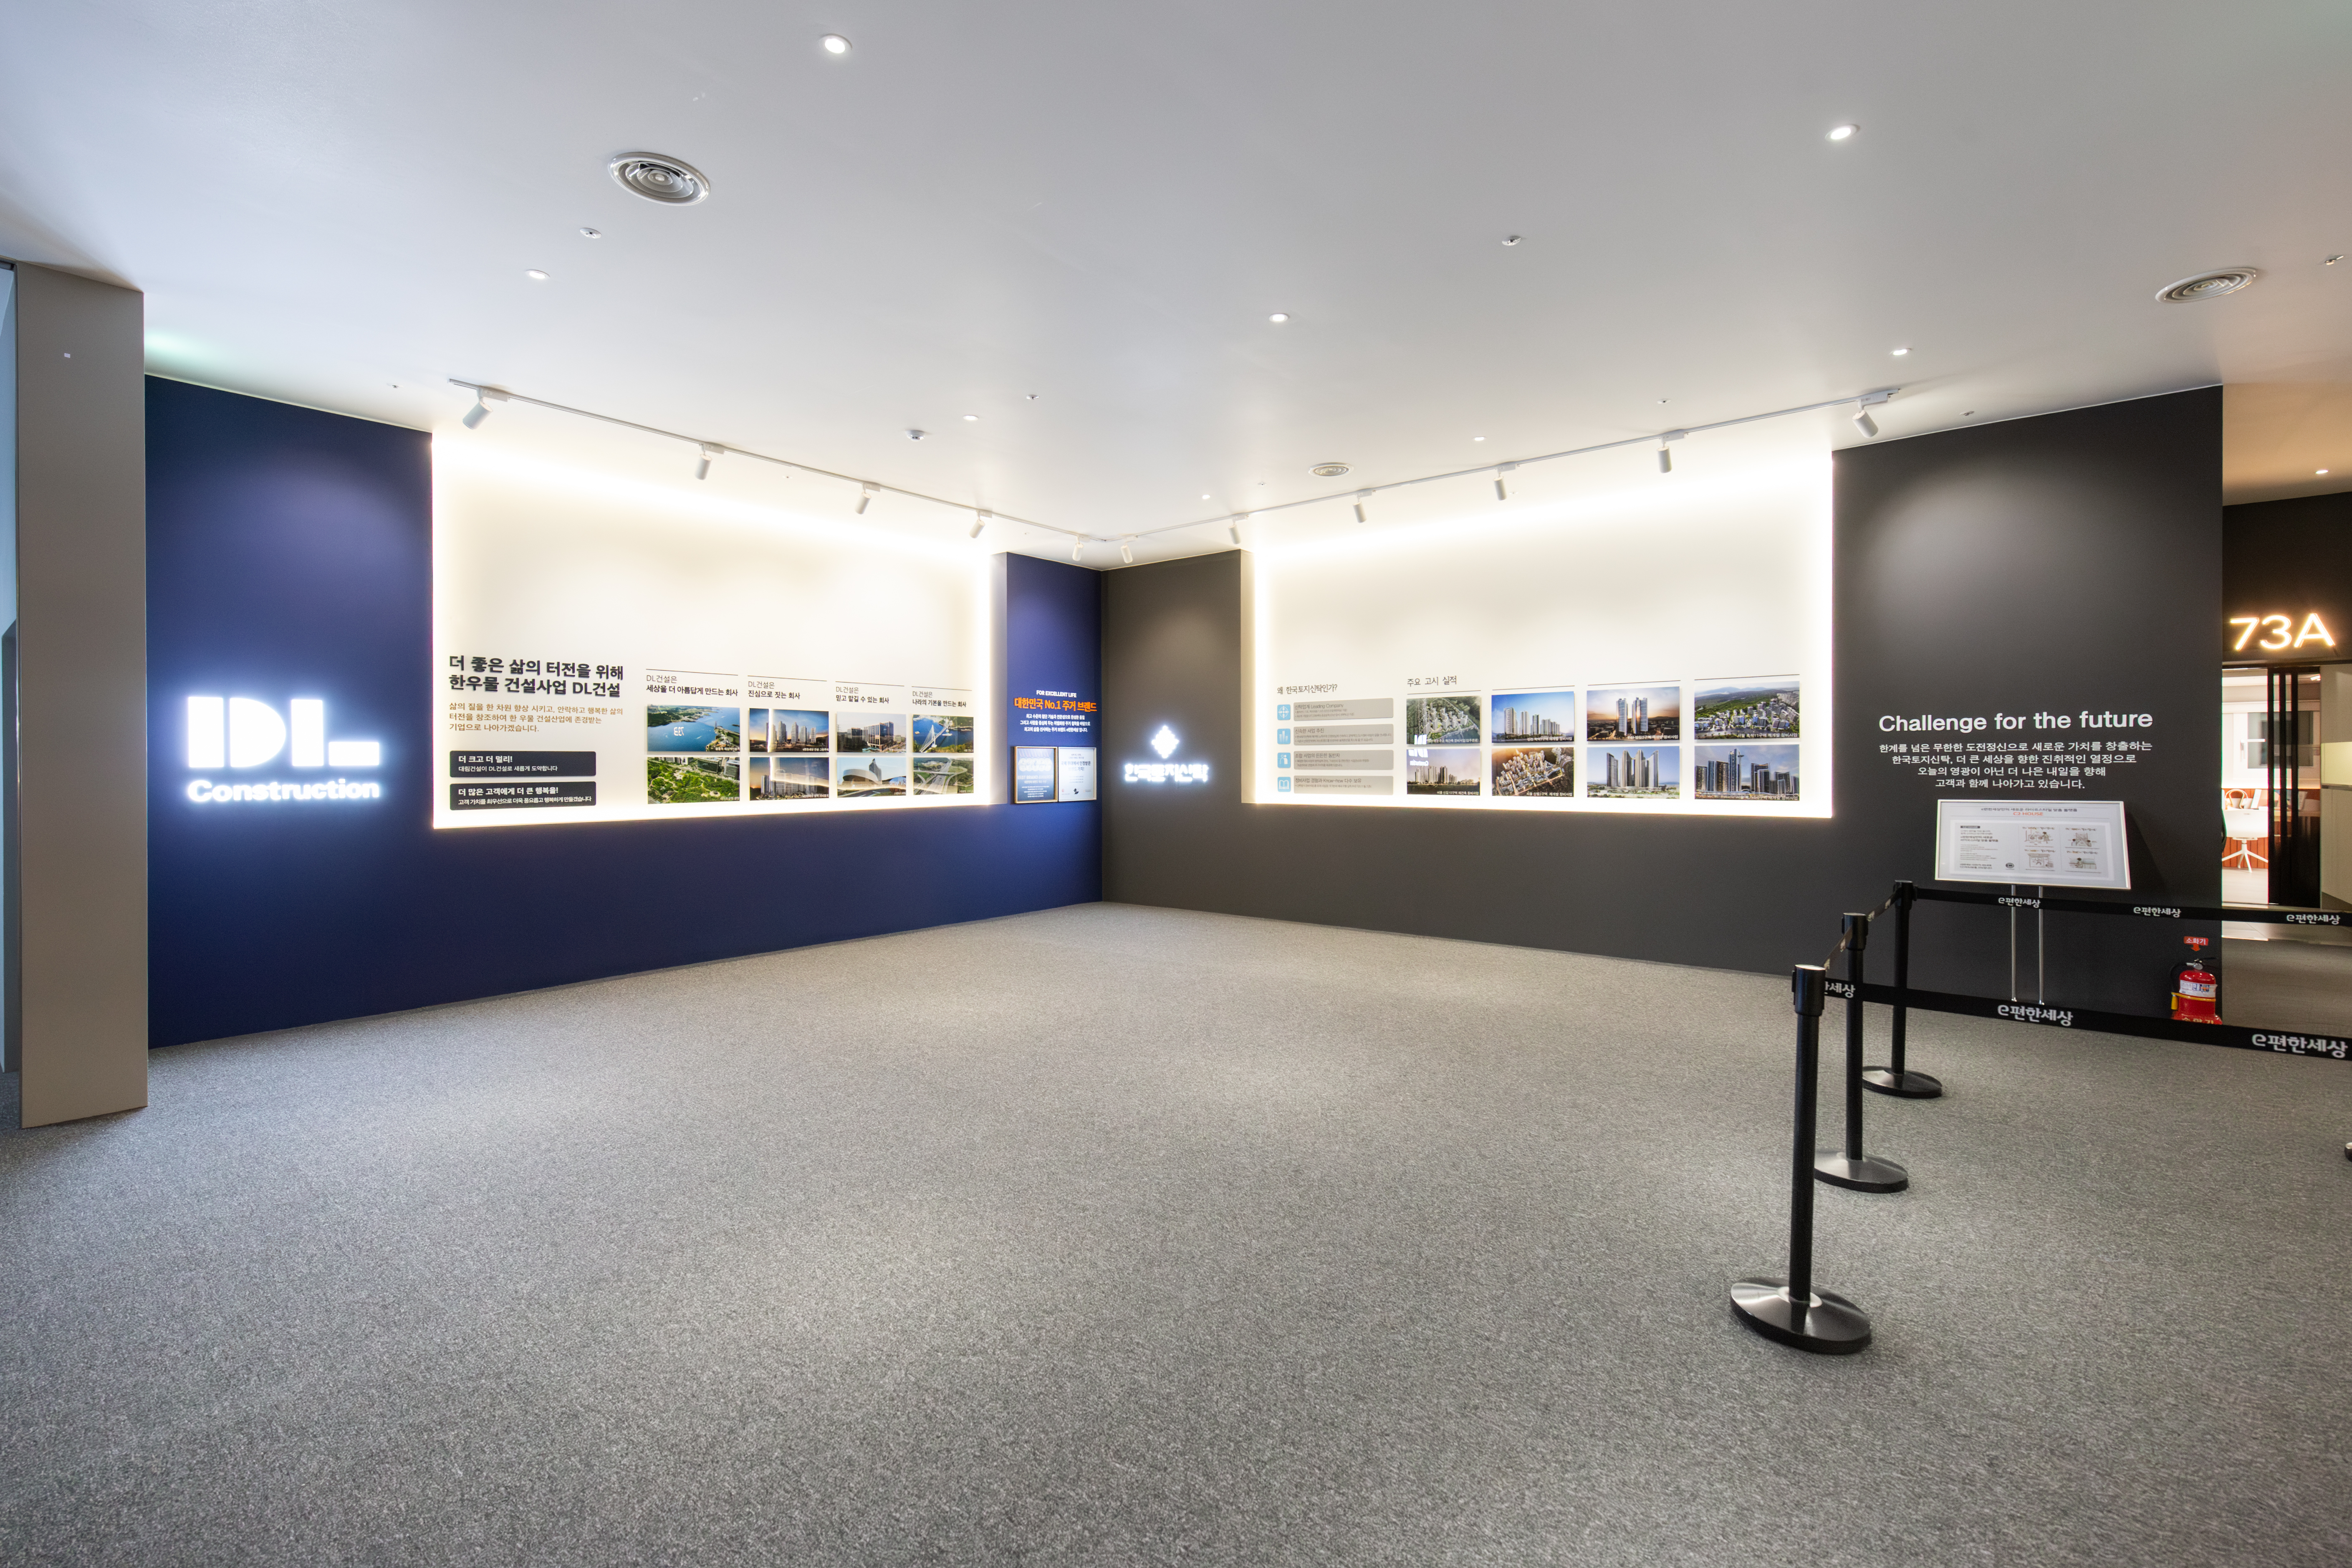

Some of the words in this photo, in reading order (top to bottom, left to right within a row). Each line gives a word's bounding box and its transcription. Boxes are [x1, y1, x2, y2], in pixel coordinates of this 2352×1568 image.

[2230, 613, 2335, 651] 73A
[450, 656, 464, 670] 더
[471, 656, 504, 673] 좋은
[509, 659, 540, 675] 삶의
[547, 662, 591, 678] 터전을
[596, 665, 623, 680] 위해
[647, 675, 677, 684] DL건설은
[748, 681, 775, 689] DL건설은
[1407, 678, 1421, 687] 주요
[1425, 677, 1438, 686] 고시
[1443, 676, 1457, 685] 실적
[449, 675, 499, 692] 한우물
[505, 678, 566, 694] 건설사업
[573, 682, 620, 697] DL건설
[646, 684, 667, 693] 세상을
[677, 686, 703, 694] 아름답게
[1286, 684, 1338, 694] 한국토지신탁인가?
[1014, 697, 1043, 710] 대한민국
[1044, 699, 1061, 709] No.1
[1062, 700, 1076, 711] 주거
[1077, 702, 1097, 712] 브랜드
[1879, 715, 1987, 733] Challenge
[1994, 713, 2026, 730] for
[2034, 712, 2071, 729] the
[2079, 711, 2153, 728] future
[1880, 744, 1907, 752] 한계를
[1911, 744, 1930, 752] 넘은
[1933, 743, 1963, 752] 무한한
[1966, 743, 2029, 752] 도전정신으로
[2032, 742, 2065, 751] 새로운
[2068, 741, 2102, 751] 가치를
[2105, 741, 2152, 751] 창출하는
[1892, 755, 1953, 764] 한국토지신탁,
[1956, 755, 1965, 764] 더
[1983, 755, 2014, 764] 세상을
[2017, 755, 2039, 764] 향한
[2041, 754, 2086, 764] 진취적인
[2090, 754, 2137, 764] 열정으로
[1917, 767, 1947, 775] 오늘의
[1950, 767, 1980, 776] 영광이
[1984, 767, 2004, 776] 아닌
[2008, 767, 2018, 776] 더
[2022, 767, 2044, 776] 나은
[2046, 767, 2080, 776] 내일을
[2084, 766, 2106, 776] 향해
[1935, 779, 1965, 788] 고객과
[1968, 779, 1988, 788] 함께
[1993, 779, 2035, 788] 나아가고
[2038, 779, 2085, 789] 있습니다.
[188, 779, 379, 802] Construction
[1998, 897, 2041, 908] e편한세상
[2133, 907, 2182, 918] e편한세상
[2286, 914, 2340, 925] e편한세상
[1997, 1005, 2073, 1026] e편한세상
[2252, 1034, 2348, 1058] e편한세상
